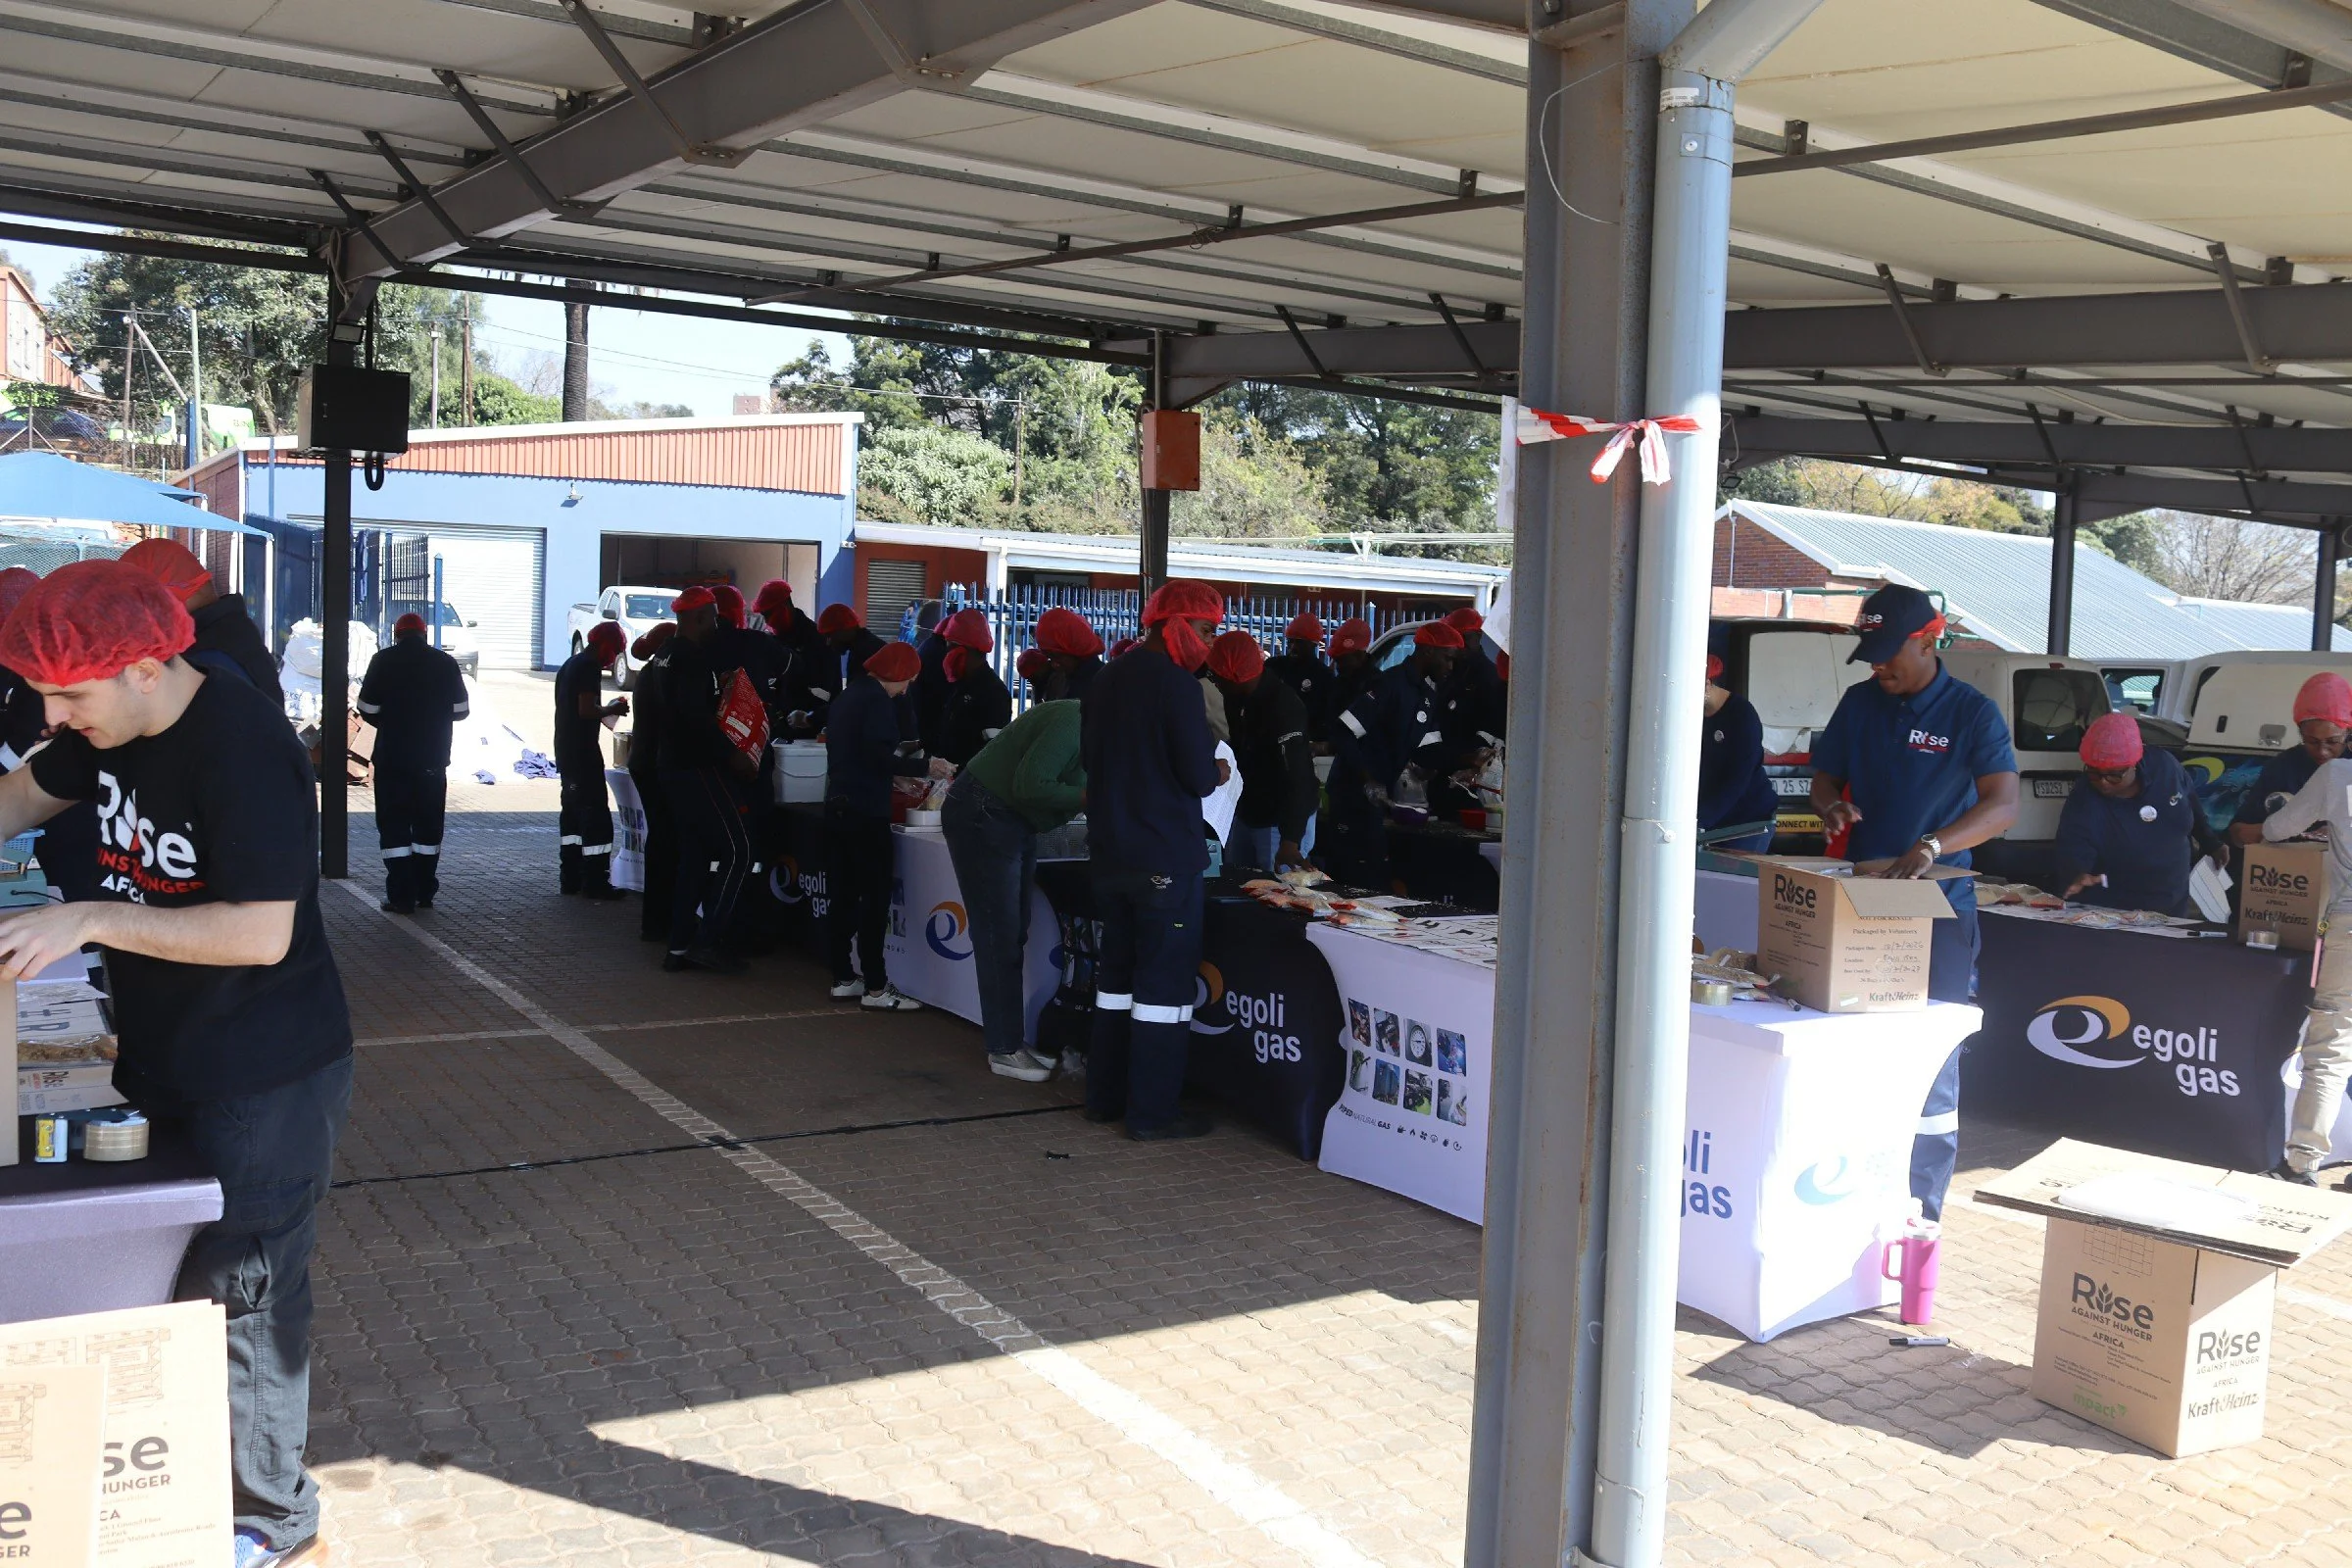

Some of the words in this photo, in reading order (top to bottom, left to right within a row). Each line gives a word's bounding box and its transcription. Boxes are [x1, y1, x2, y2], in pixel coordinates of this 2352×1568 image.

[1783, 780, 1794, 794] 25
[798, 870, 827, 897] egoli
[1774, 873, 1817, 909] Rise
[2249, 864, 2309, 891] Rise
[1226, 990, 1284, 1029] egoli
[1253, 1030, 1301, 1063] gas
[2132, 1024, 2218, 1062] egoli
[2175, 1062, 2241, 1097] gas
[2072, 1271, 2154, 1330] Rise
[2072, 1306, 2111, 1326] AGAINST
[2113, 1321, 2153, 1343] HUNGER
[2092, 1331, 2125, 1349] AFRICA
[2197, 1328, 2261, 1364] Rise
[2196, 1361, 2227, 1375] AGAINST
[2230, 1355, 2260, 1368] HUNGER
